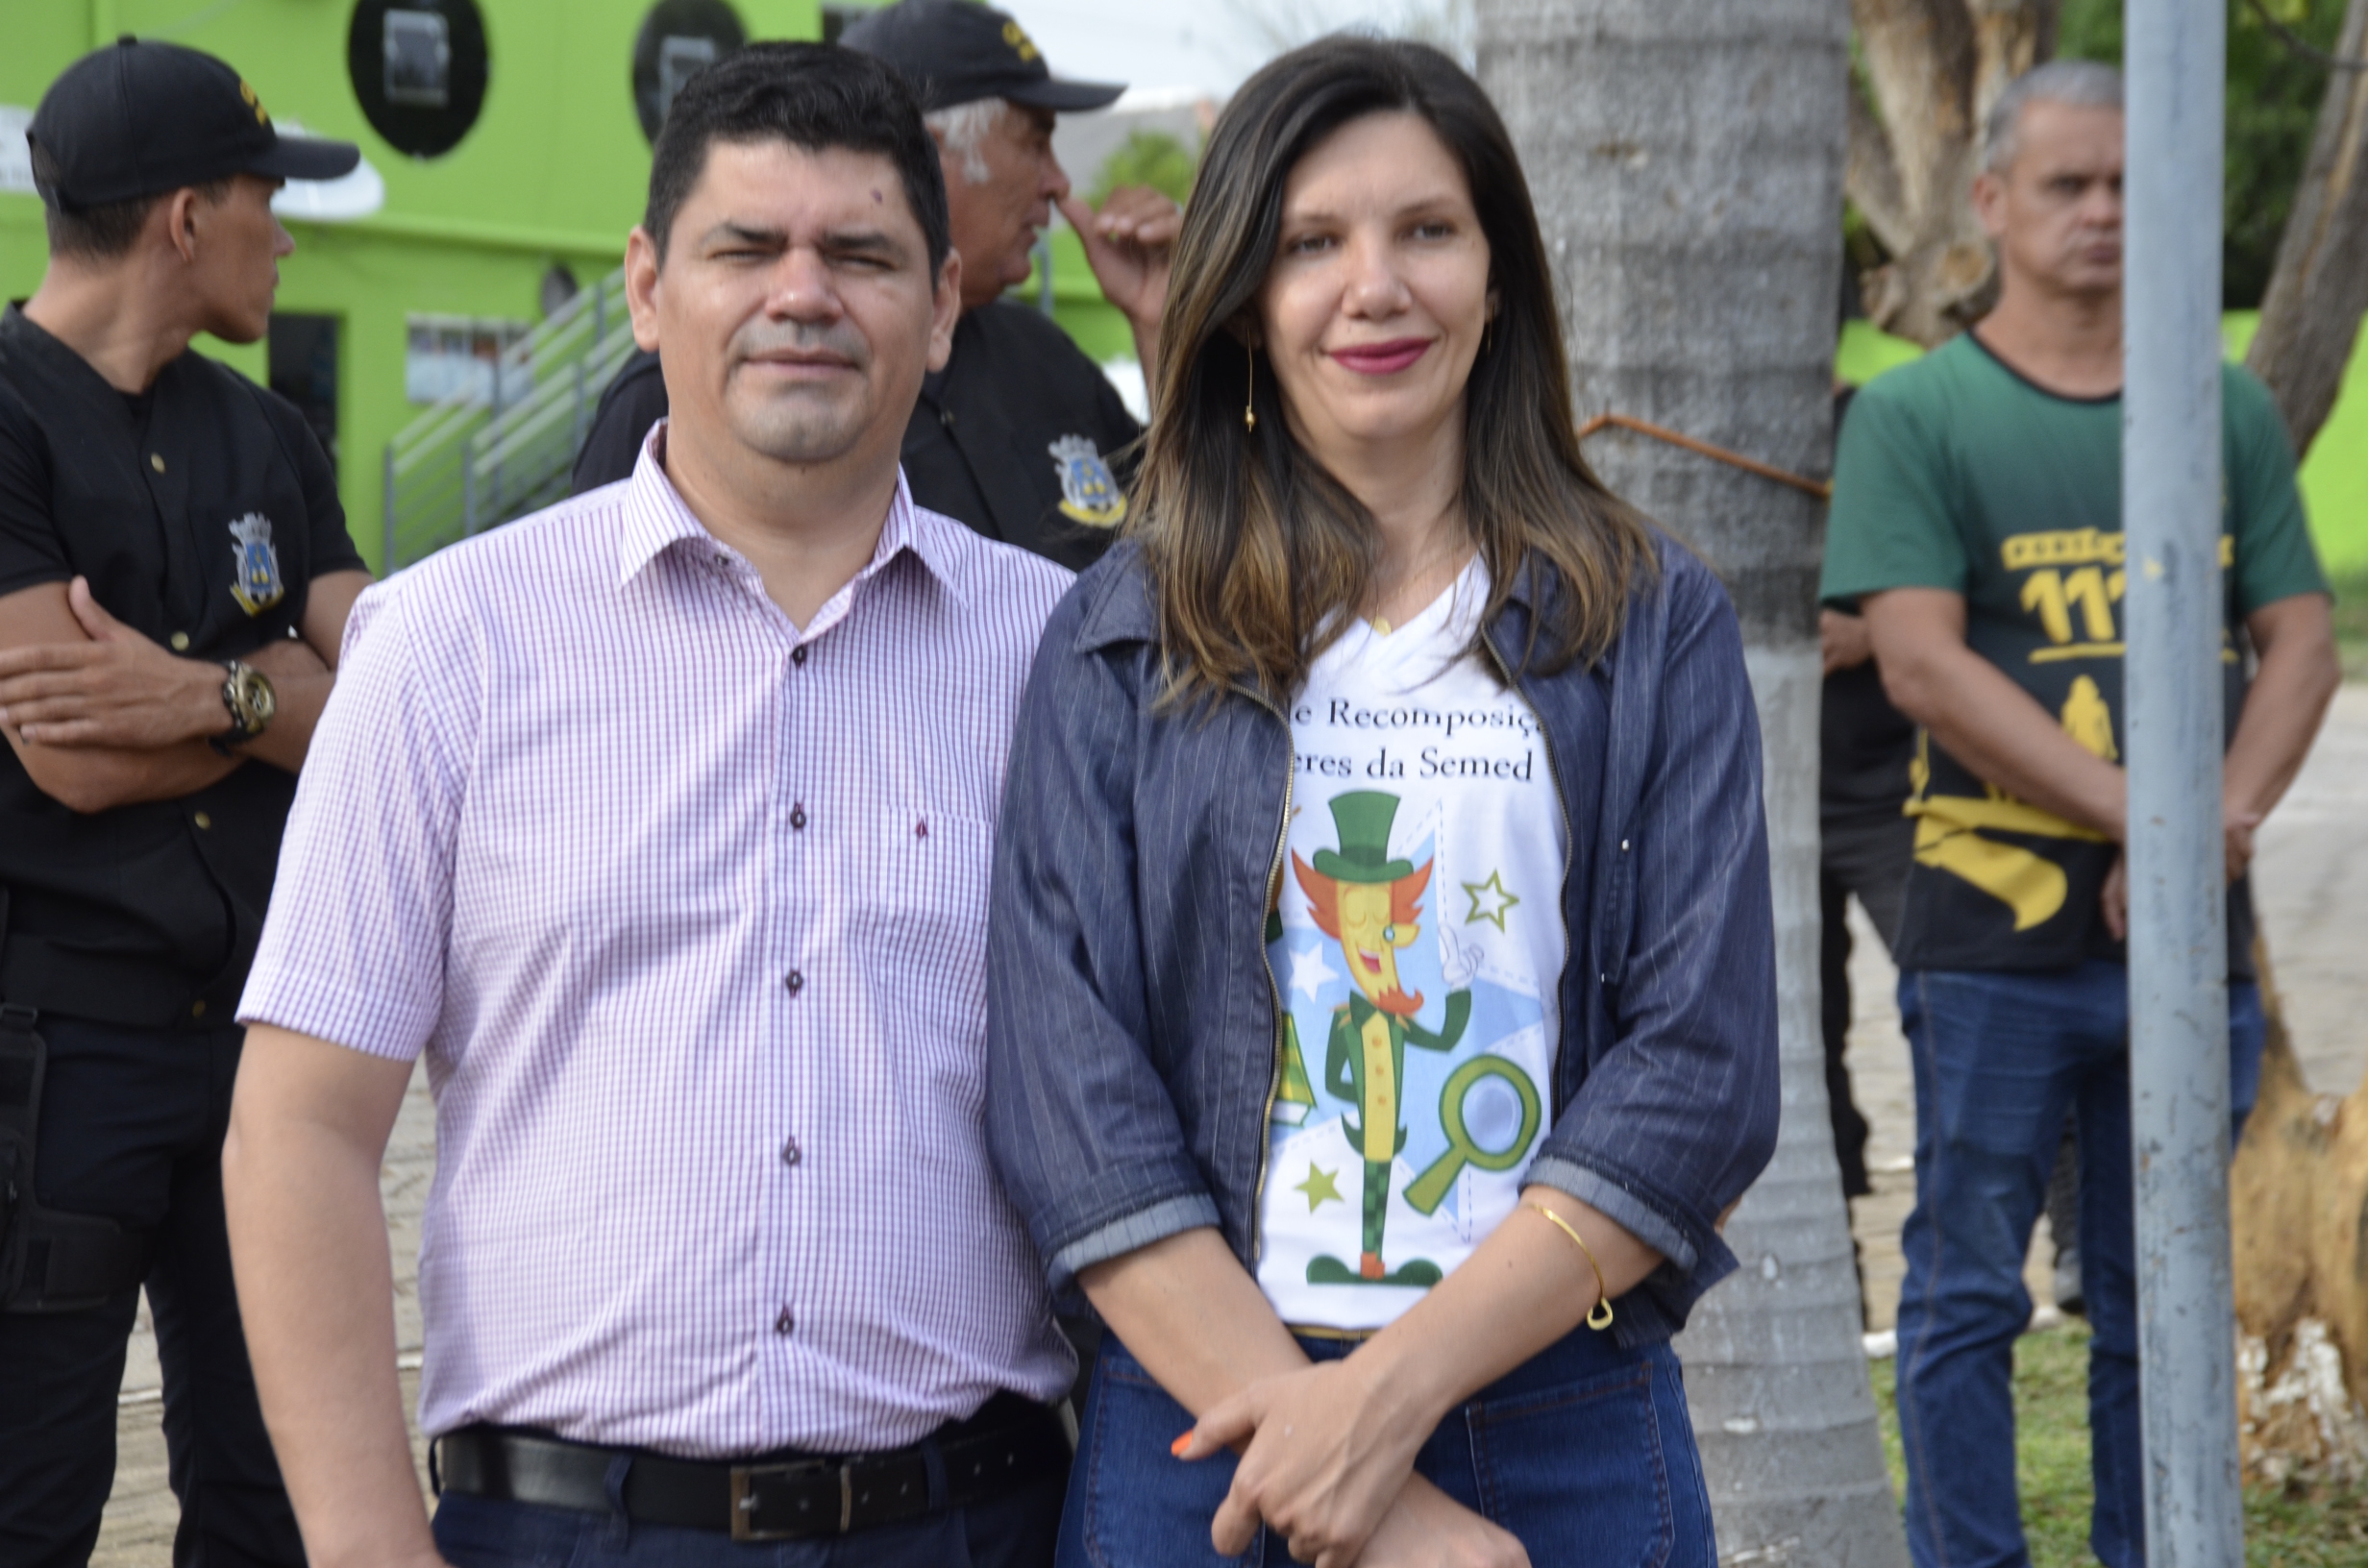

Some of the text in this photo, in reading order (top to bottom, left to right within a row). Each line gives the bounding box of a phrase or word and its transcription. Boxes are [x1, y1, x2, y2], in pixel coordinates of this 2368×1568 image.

[1329, 697, 1541, 739] Recomposiç
[1367, 747, 1405, 780] da
[1420, 746, 1533, 783] Semed
